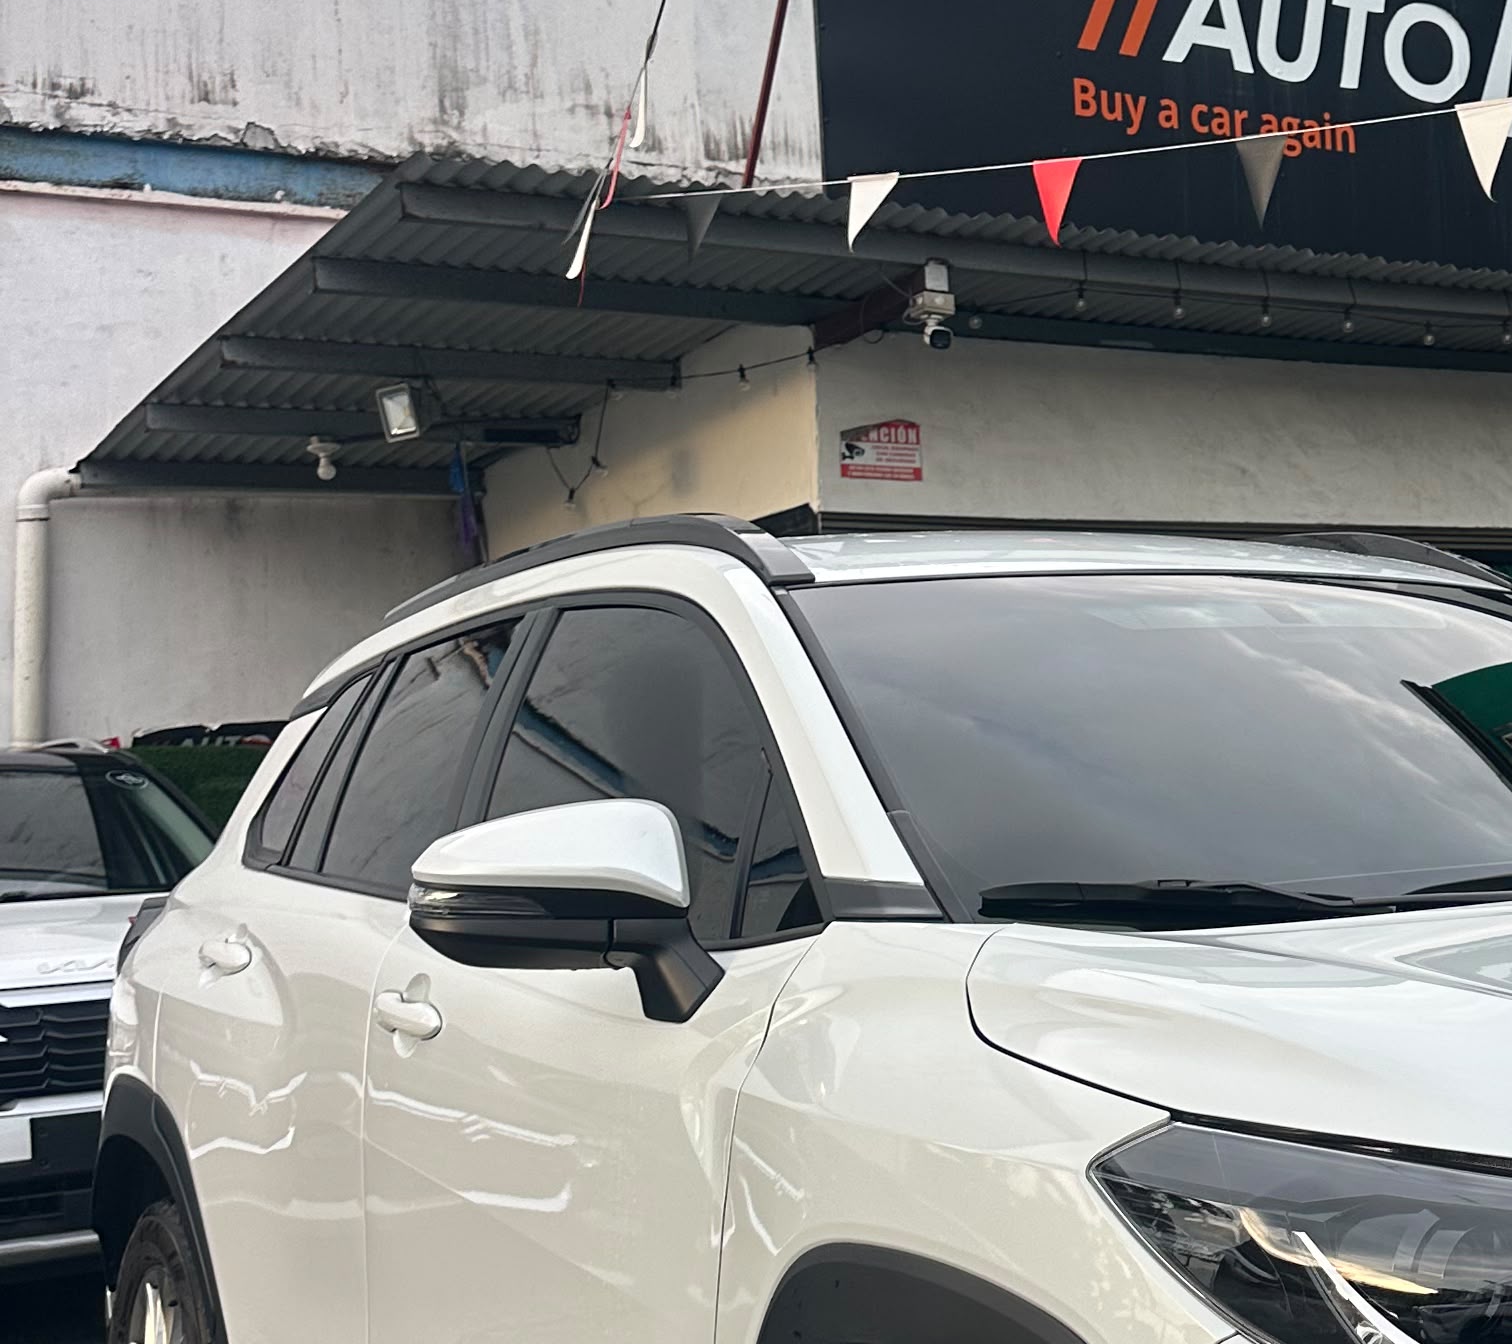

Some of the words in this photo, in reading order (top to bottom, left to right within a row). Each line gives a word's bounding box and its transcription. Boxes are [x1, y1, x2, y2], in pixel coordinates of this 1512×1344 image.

[1073, 77, 1147, 136] Buy
[1158, 98, 1179, 129] a
[1191, 104, 1249, 137] car
[1259, 112, 1357, 158] again
[862, 424, 918, 443] NCIÓN
